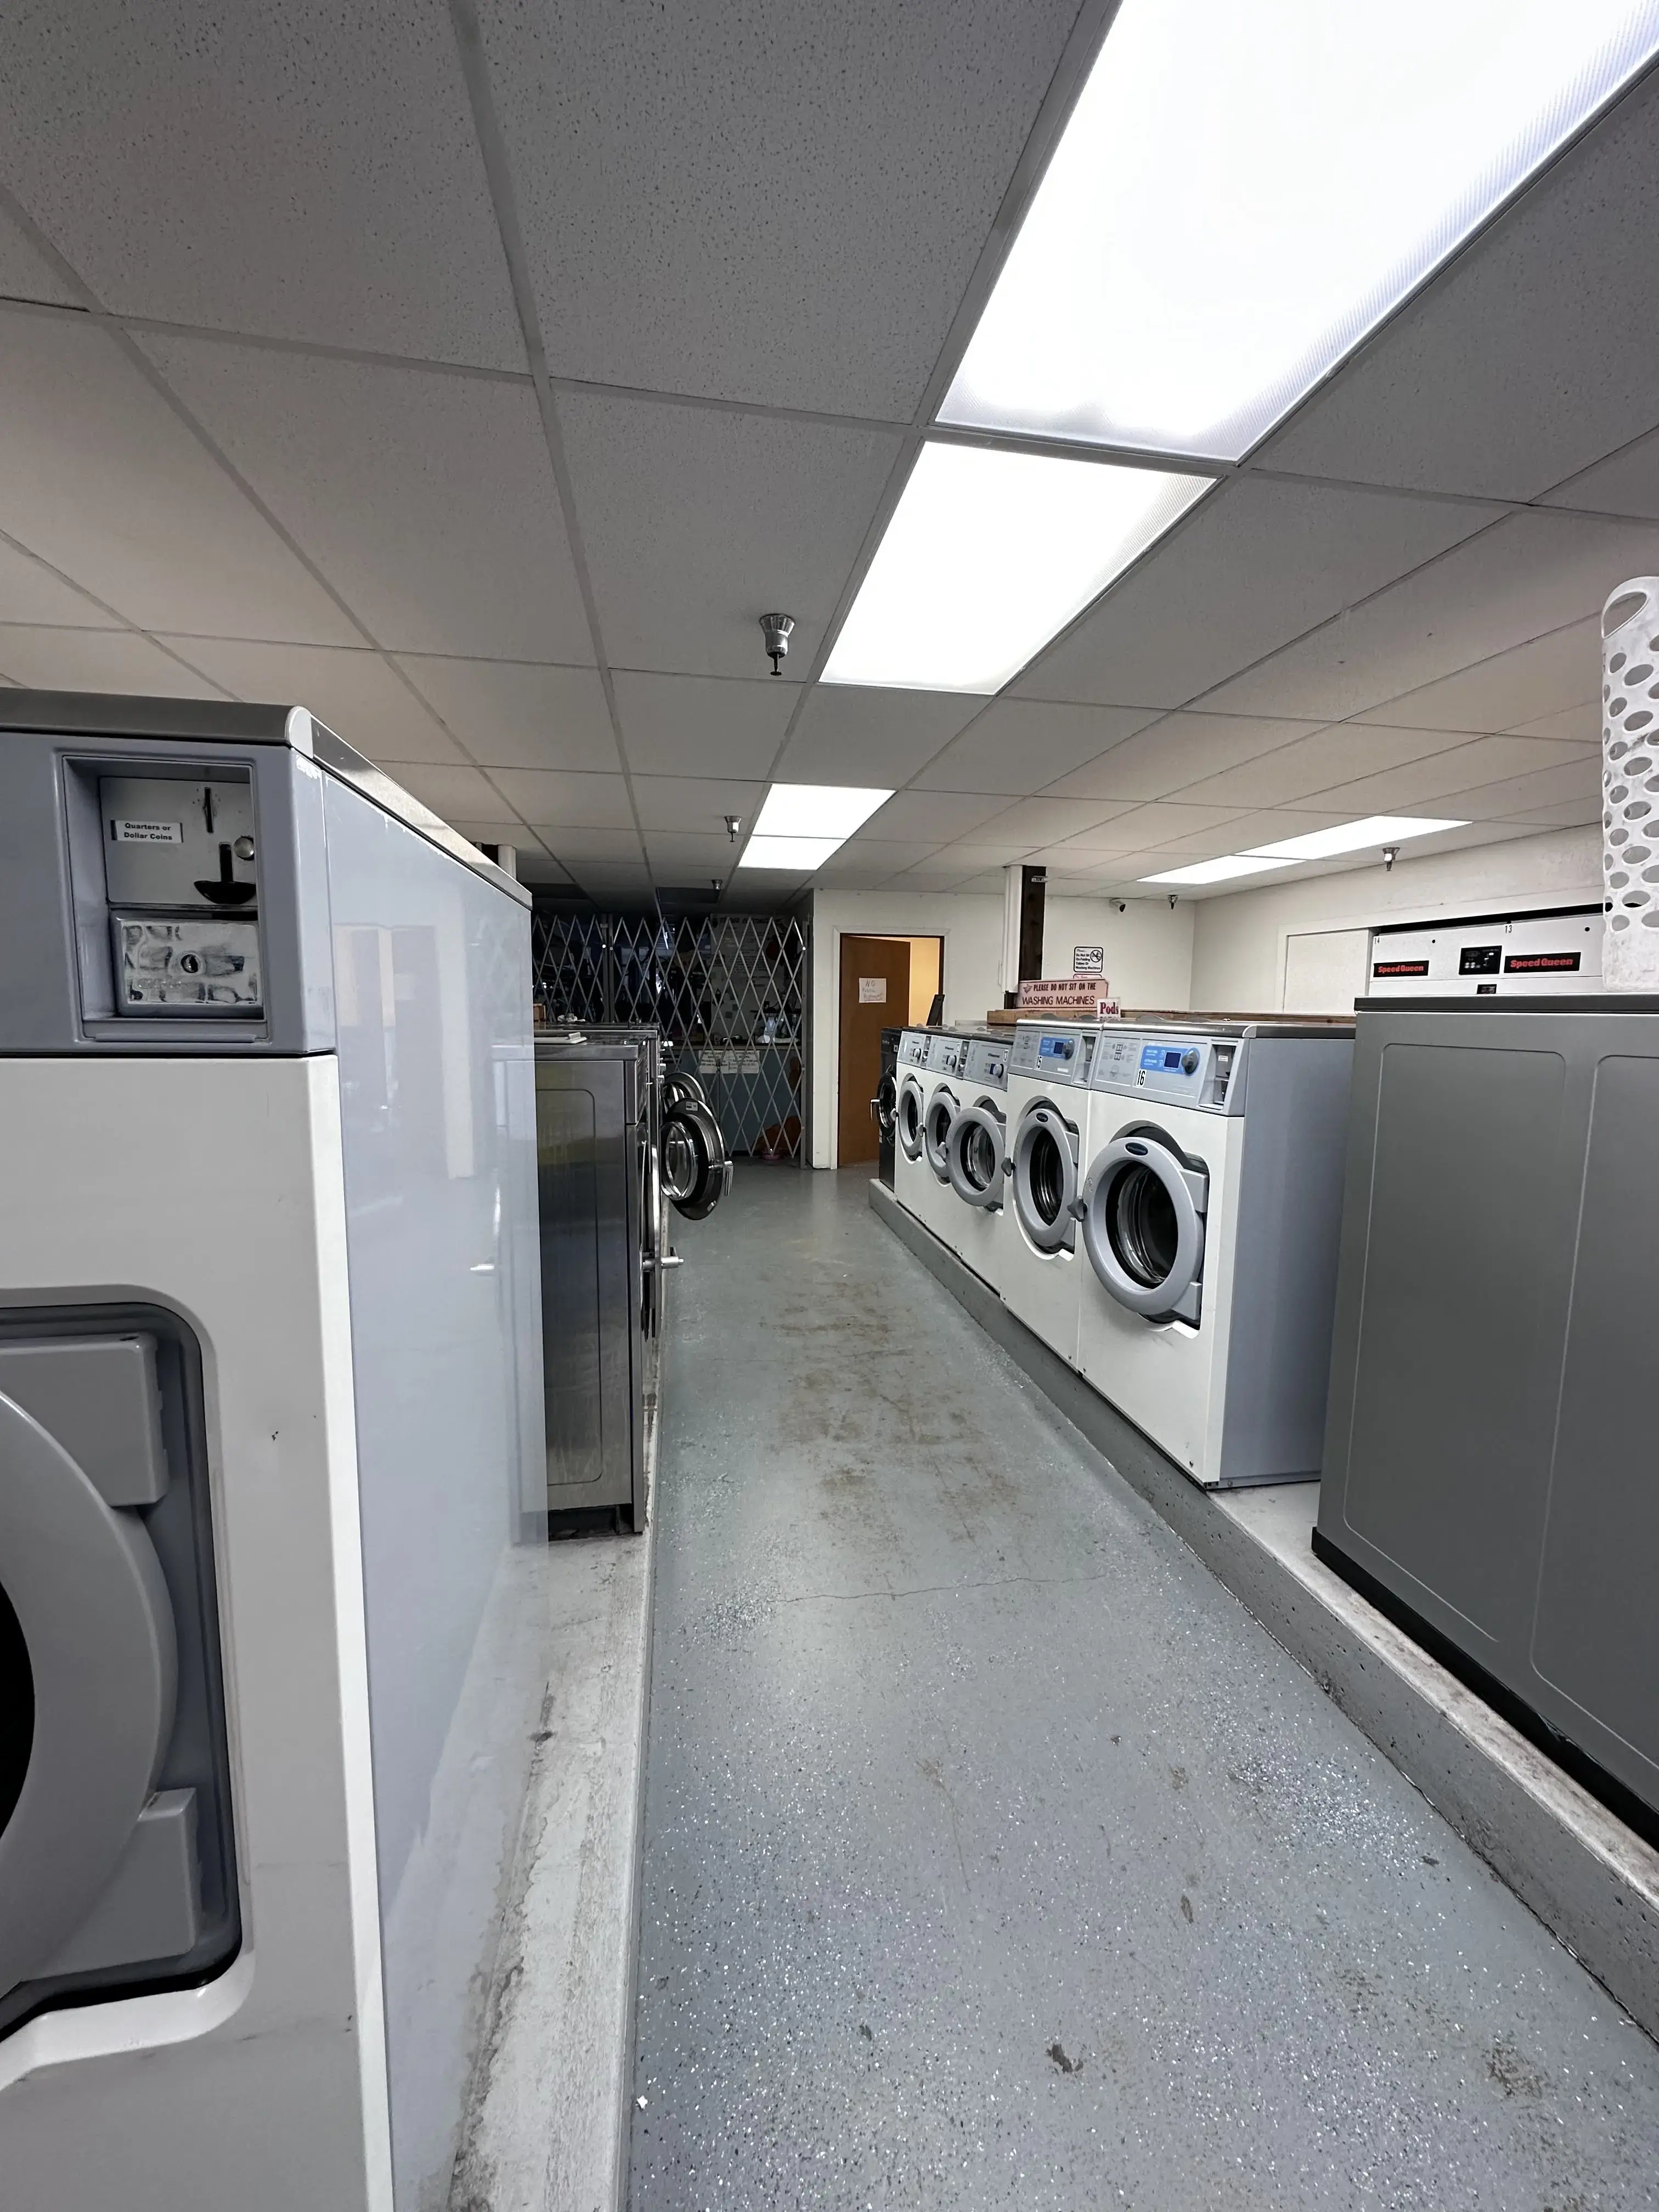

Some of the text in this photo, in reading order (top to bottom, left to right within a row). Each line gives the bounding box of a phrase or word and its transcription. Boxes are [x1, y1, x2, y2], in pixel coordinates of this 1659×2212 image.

[1505, 925, 1513, 933] 13
[1510, 958, 1573, 968] Speed Queen
[1378, 965, 1400, 974] Speed
[1022, 996, 1095, 1005] WASHING MACHINES
[1099, 1002, 1119, 1014] Pods
[1036, 1056, 1042, 1068] 15
[1137, 1070, 1145, 1086] 16
